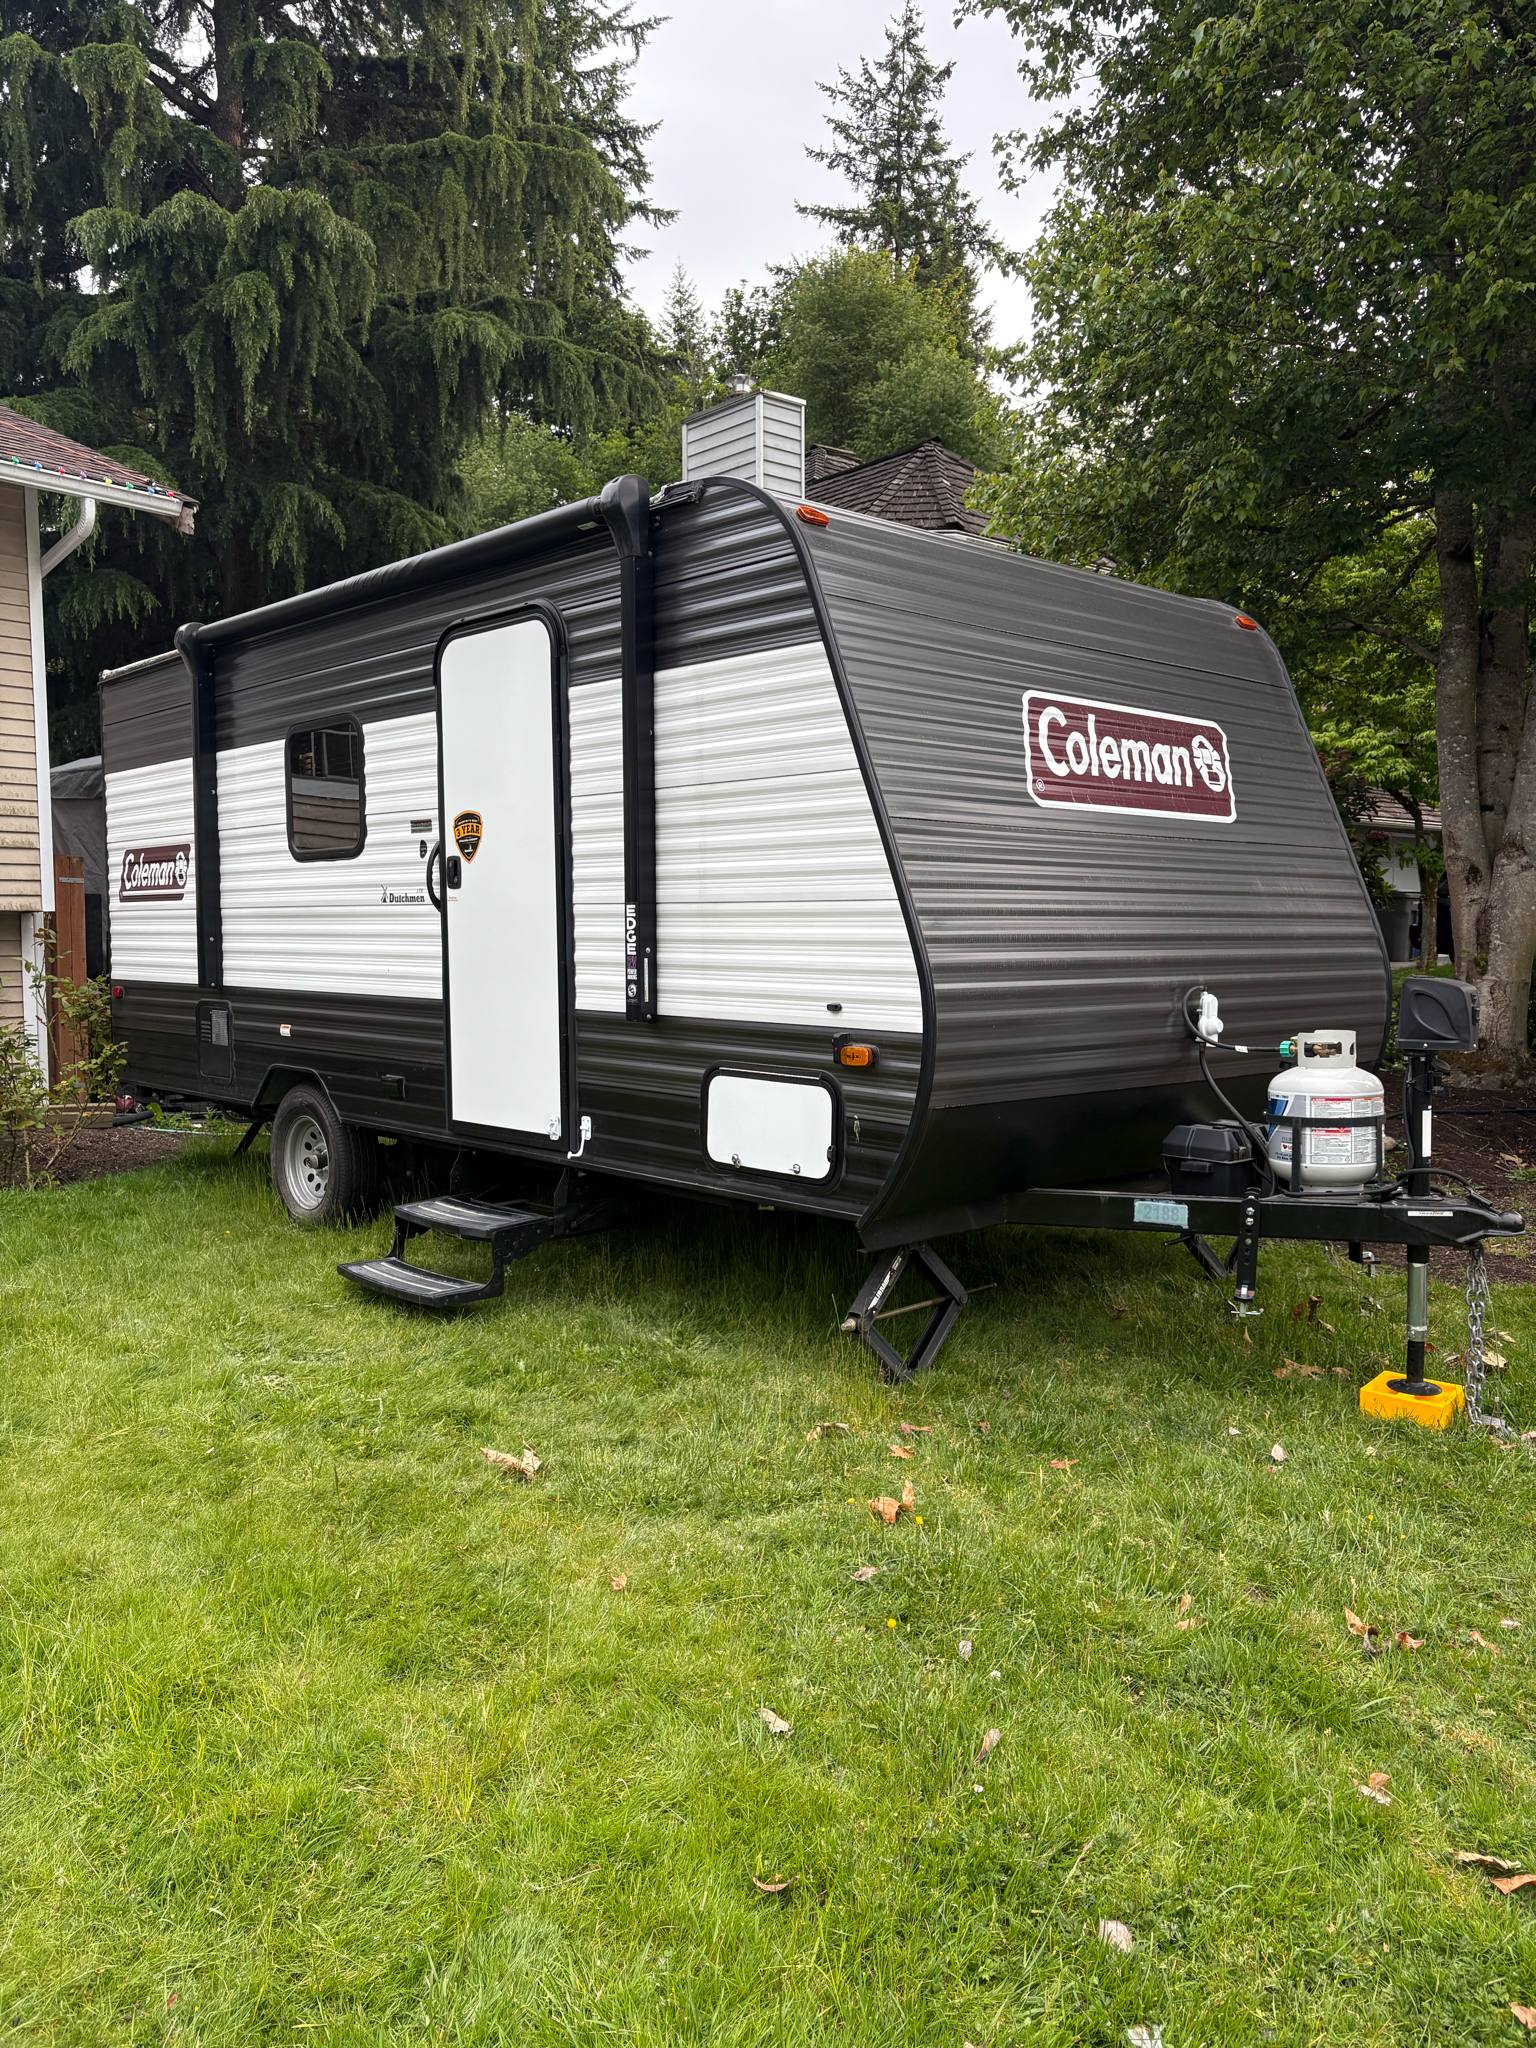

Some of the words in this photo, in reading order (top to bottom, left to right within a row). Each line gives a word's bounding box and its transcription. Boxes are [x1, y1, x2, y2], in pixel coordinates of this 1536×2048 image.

[1038, 706, 1193, 787] Coleman
[461, 824, 480, 834] YEAR
[124, 852, 175, 890] Coleman
[389, 892, 425, 903] Dutchmen
[626, 904, 637, 955] EDGE
